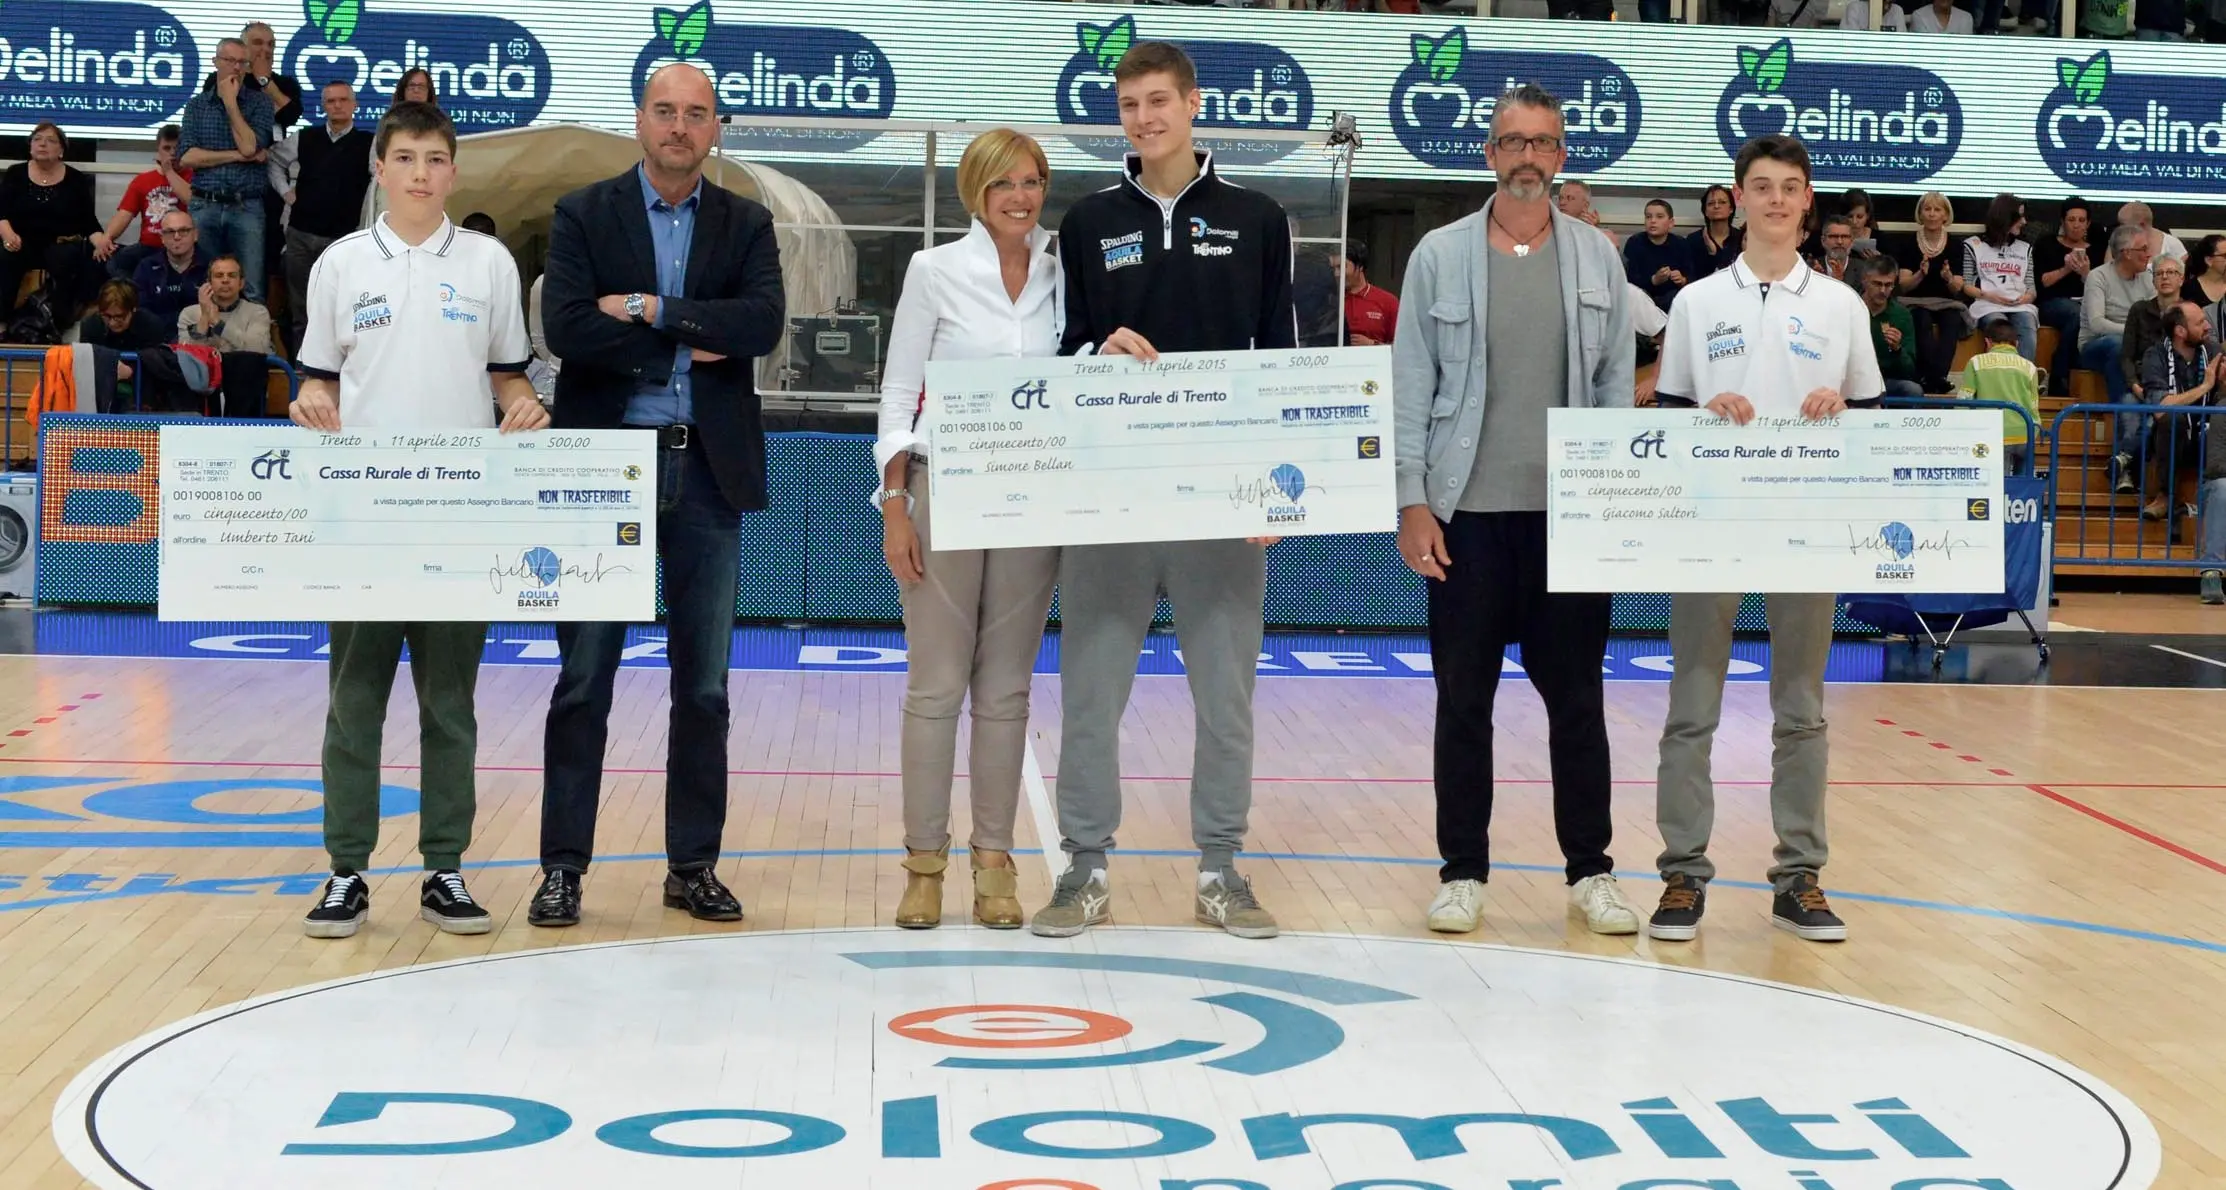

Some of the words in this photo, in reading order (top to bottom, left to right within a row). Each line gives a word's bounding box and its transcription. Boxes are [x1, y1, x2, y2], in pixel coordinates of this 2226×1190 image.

[9, 96, 55, 109] MELA
[61, 97, 92, 110] VAL
[97, 98, 113, 111] DI
[119, 99, 162, 112] NON
[472, 111, 515, 124] NON
[1729, 88, 1948, 144] Melinda
[1838, 155, 1863, 167] VAL
[1870, 156, 1885, 168] DI
[1890, 156, 1930, 169] NON
[2111, 163, 2151, 177] MELA
[2156, 165, 2182, 178] VAL
[2187, 166, 2201, 178] DI
[1100, 231, 1143, 249] SPALDING
[1104, 245, 1142, 261] AQUILA
[1105, 254, 1143, 270] BASKET
[354, 307, 391, 323] AQUILA
[354, 315, 392, 331] BASKET
[1708, 337, 1745, 352] AQUILA
[1708, 346, 1745, 361] BASKET
[1074, 363, 1113, 374] Trento
[1157, 358, 1193, 376] aprile
[1198, 358, 1227, 371] 2015
[1288, 355, 1329, 368] 500,00
[1075, 393, 1114, 407] Cassa
[1119, 391, 1162, 405] Rurale
[1166, 390, 1179, 403] di
[1183, 390, 1226, 403] Trento
[1282, 407, 1301, 421] NON
[1305, 405, 1370, 420] TRASFERIBILE
[940, 422, 1006, 434] 0019008106
[1009, 421, 1023, 431] 00
[1757, 416, 1768, 426] 11
[1901, 417, 1941, 428] 500,00
[320, 434, 361, 446] Trento
[391, 435, 404, 447] 11
[407, 435, 447, 452] aprile
[450, 436, 482, 447] 2015
[547, 437, 590, 448] 500,00
[1692, 446, 1729, 458] Cassa
[1734, 446, 1777, 458] Rurale
[1781, 446, 1792, 458] di
[1798, 446, 1840, 458] Trento
[985, 461, 1029, 473] Simone
[1034, 458, 1073, 471] Bellan
[319, 466, 360, 480] Cassa
[365, 466, 412, 480] Rurale
[416, 466, 430, 480] di
[435, 467, 481, 480] Trento
[1560, 469, 1624, 479] 0019008106
[1627, 469, 1640, 479] 00
[1894, 468, 1911, 480] NON
[1917, 468, 1980, 480] TRASFERIBILE
[173, 490, 244, 501] 0019008106
[248, 491, 262, 501] 00
[398, 498, 424, 508] pagate
[426, 499, 439, 507] per
[441, 498, 465, 507] questo
[467, 497, 499, 507] Assegno
[501, 498, 534, 506] Bancario
[538, 490, 558, 503] NON
[562, 490, 631, 503] TRASFERIBILE
[203, 508, 308, 526] cinquecento/00
[1267, 506, 1306, 515] AQUILA
[1602, 508, 1654, 521] Giacomo
[1658, 506, 1698, 519] Saltori
[1267, 514, 1306, 523] BASKET
[220, 532, 278, 544] Umberto
[424, 564, 442, 572] firma
[1876, 563, 1914, 571] AQUILA
[519, 591, 559, 599] AQUILA
[517, 599, 560, 607] BASKET
[281, 1091, 1972, 1162] Dolomiti
